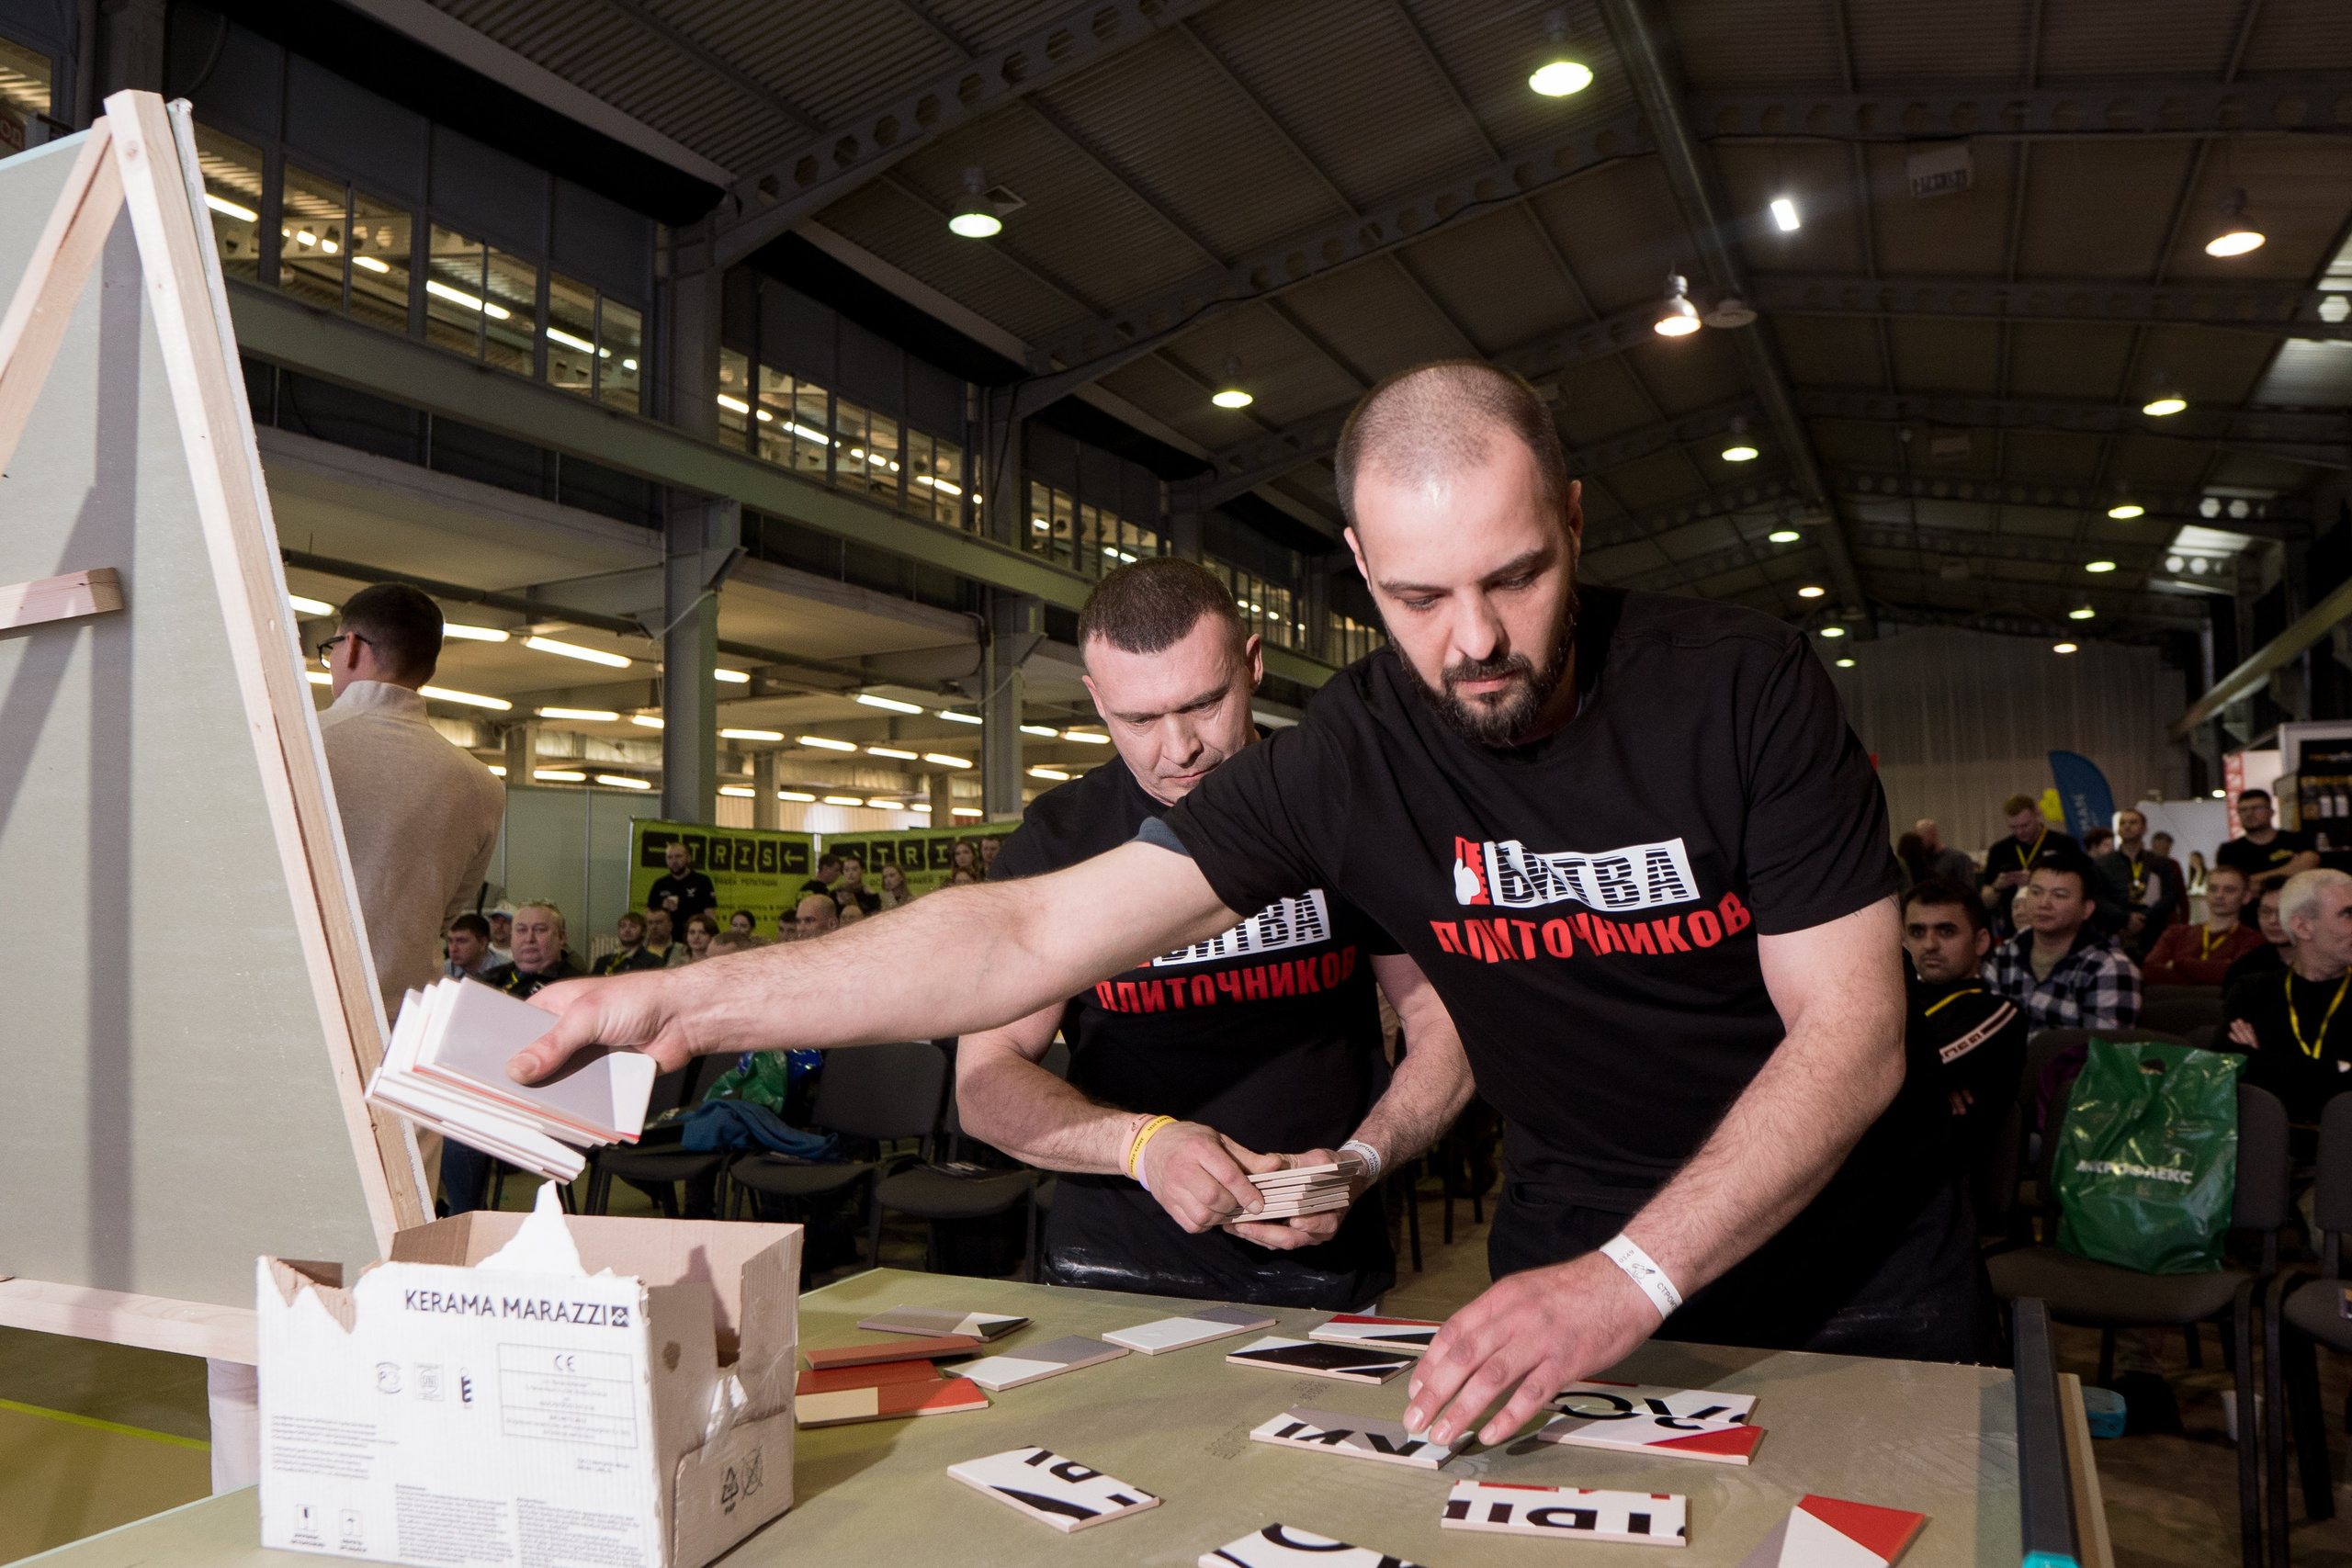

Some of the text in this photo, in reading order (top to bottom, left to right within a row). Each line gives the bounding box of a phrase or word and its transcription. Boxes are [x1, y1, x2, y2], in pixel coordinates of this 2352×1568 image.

[689, 842, 773, 867] TRIS
[1494, 843, 1690, 909] БИТВА
[1430, 891, 1751, 964] ПЛИТОЧНИКОВ
[1095, 945, 1357, 1014] ПЛИТОЧНИКОВ
[405, 1288, 606, 1325] KERAMA MARAZZI
